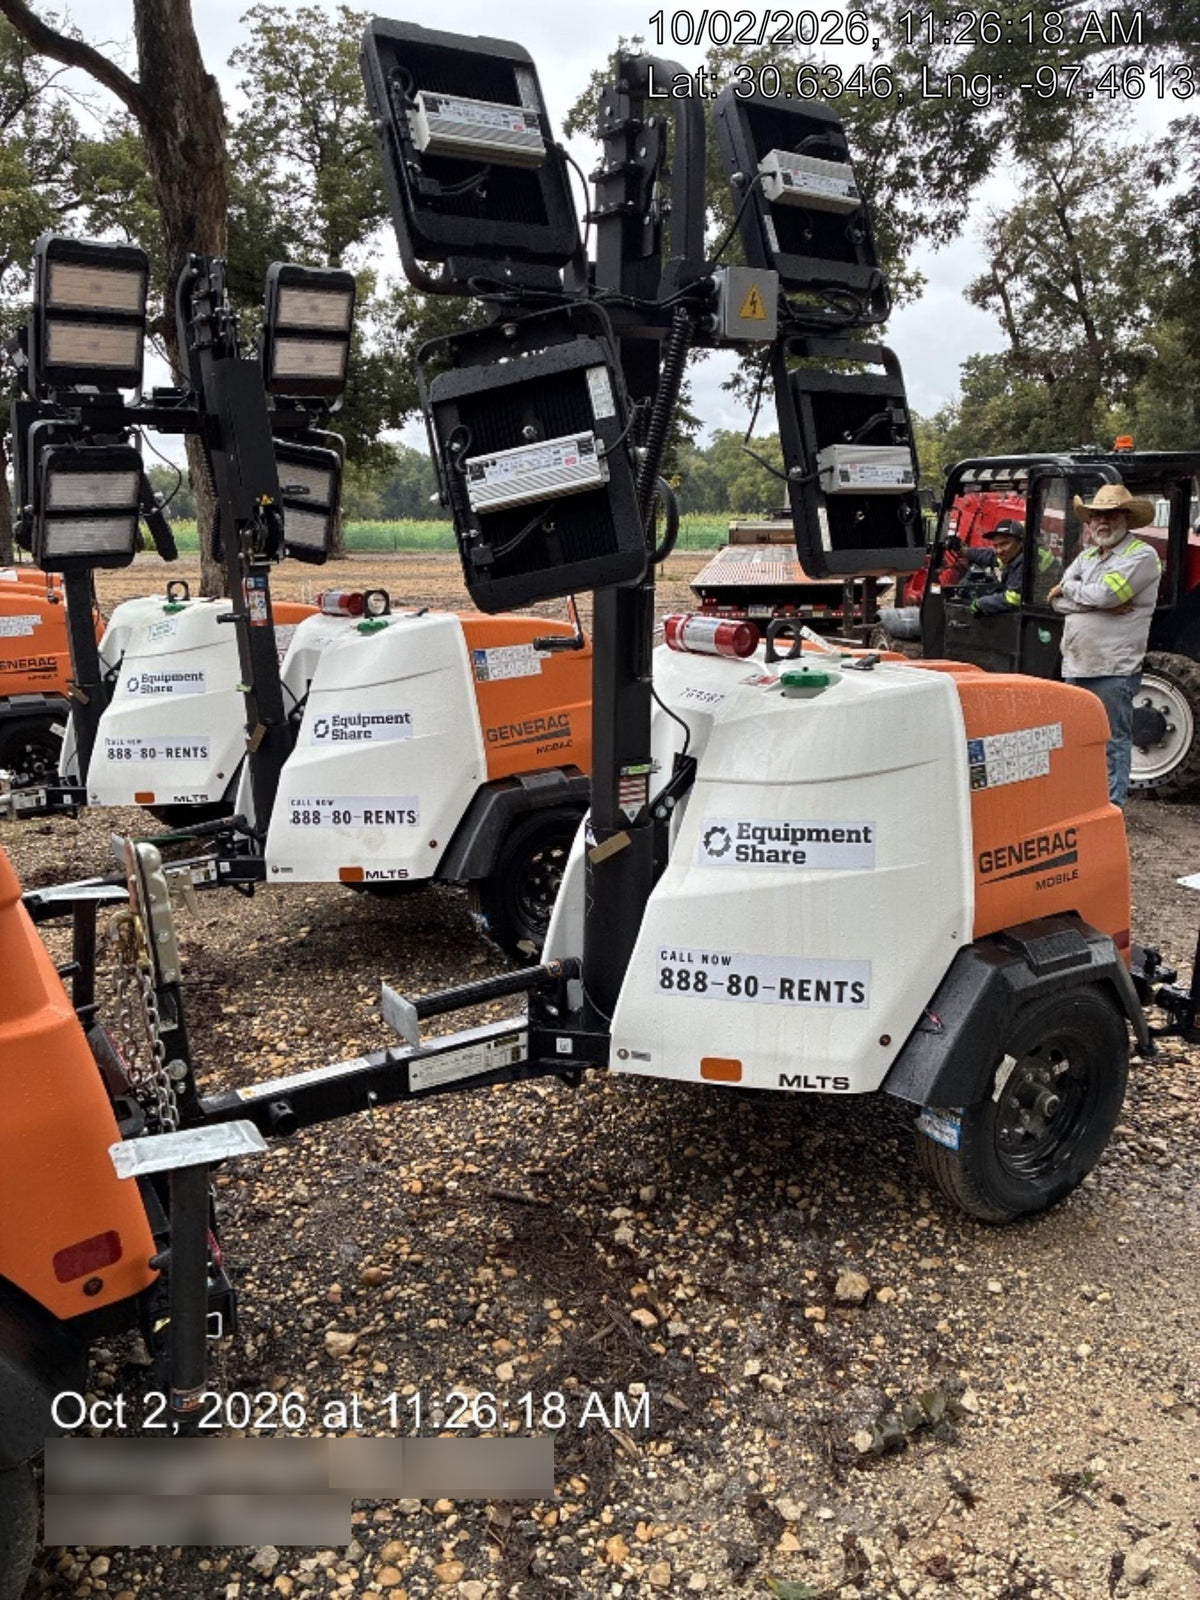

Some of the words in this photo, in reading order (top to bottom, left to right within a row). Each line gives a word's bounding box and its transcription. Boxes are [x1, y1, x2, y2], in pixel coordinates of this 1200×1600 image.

[332, 712, 411, 729] Equipment
[487, 714, 570, 743] GENERAC
[332, 728, 373, 741] Share
[108, 746, 208, 760] 888-80-RENTS
[292, 809, 416, 825] 888-80-RENTS
[736, 822, 872, 847] Equipment
[735, 844, 806, 865] Share
[979, 828, 1078, 873] GENERAC
[365, 869, 409, 879] MLTS
[1036, 869, 1079, 891] MOBILE
[660, 950, 694, 963] CALL
[702, 954, 732, 966] NOW
[659, 967, 865, 1003] 888-80-RENTS
[778, 1073, 850, 1090] MLTS
